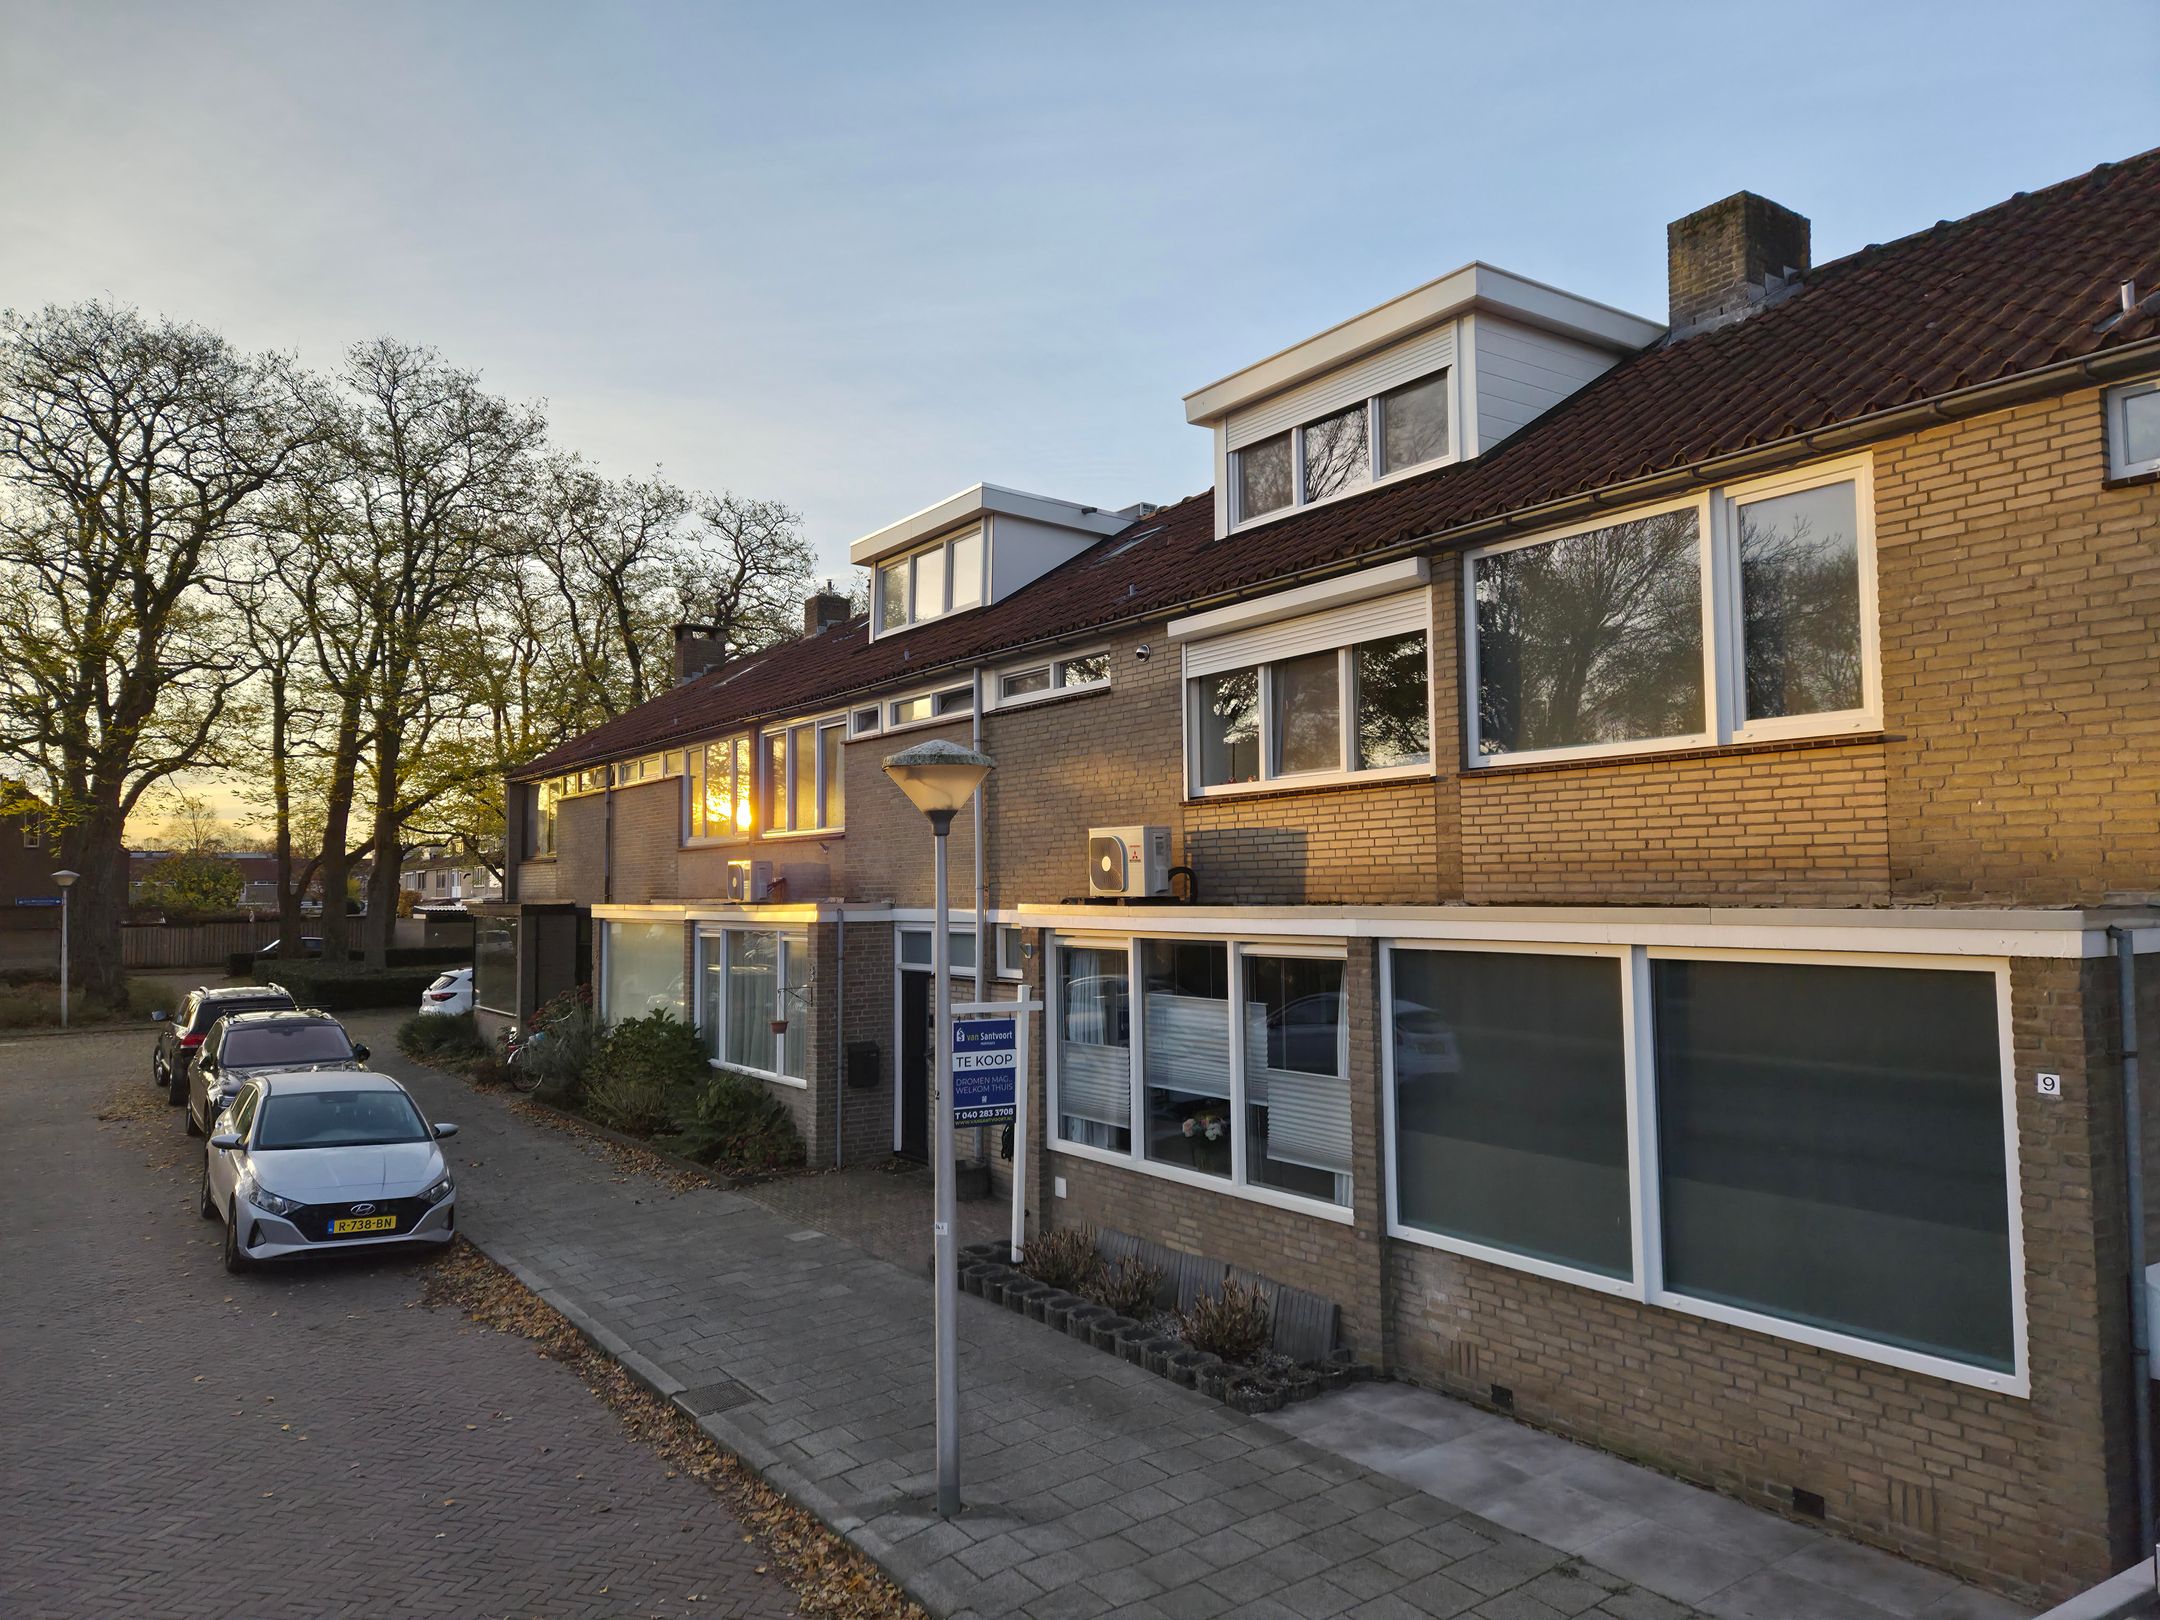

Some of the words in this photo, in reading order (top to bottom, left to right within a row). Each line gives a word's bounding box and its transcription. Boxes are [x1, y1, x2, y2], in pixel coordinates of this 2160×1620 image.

[980, 1031, 1013, 1041] Santvoort
[956, 1056, 972, 1068] TE
[975, 1053, 1013, 1067] KOOP
[955, 1076, 991, 1087] DROMEN
[2042, 1076, 2055, 1091] 9
[955, 1085, 990, 1094] WELKOM
[991, 1083, 1013, 1092] THUIS
[955, 1112, 961, 1120] T
[961, 1111, 978, 1119] 040
[979, 1109, 993, 1118] 283
[994, 1107, 1014, 1116] 3708
[338, 1218, 392, 1232] R-738-BN
